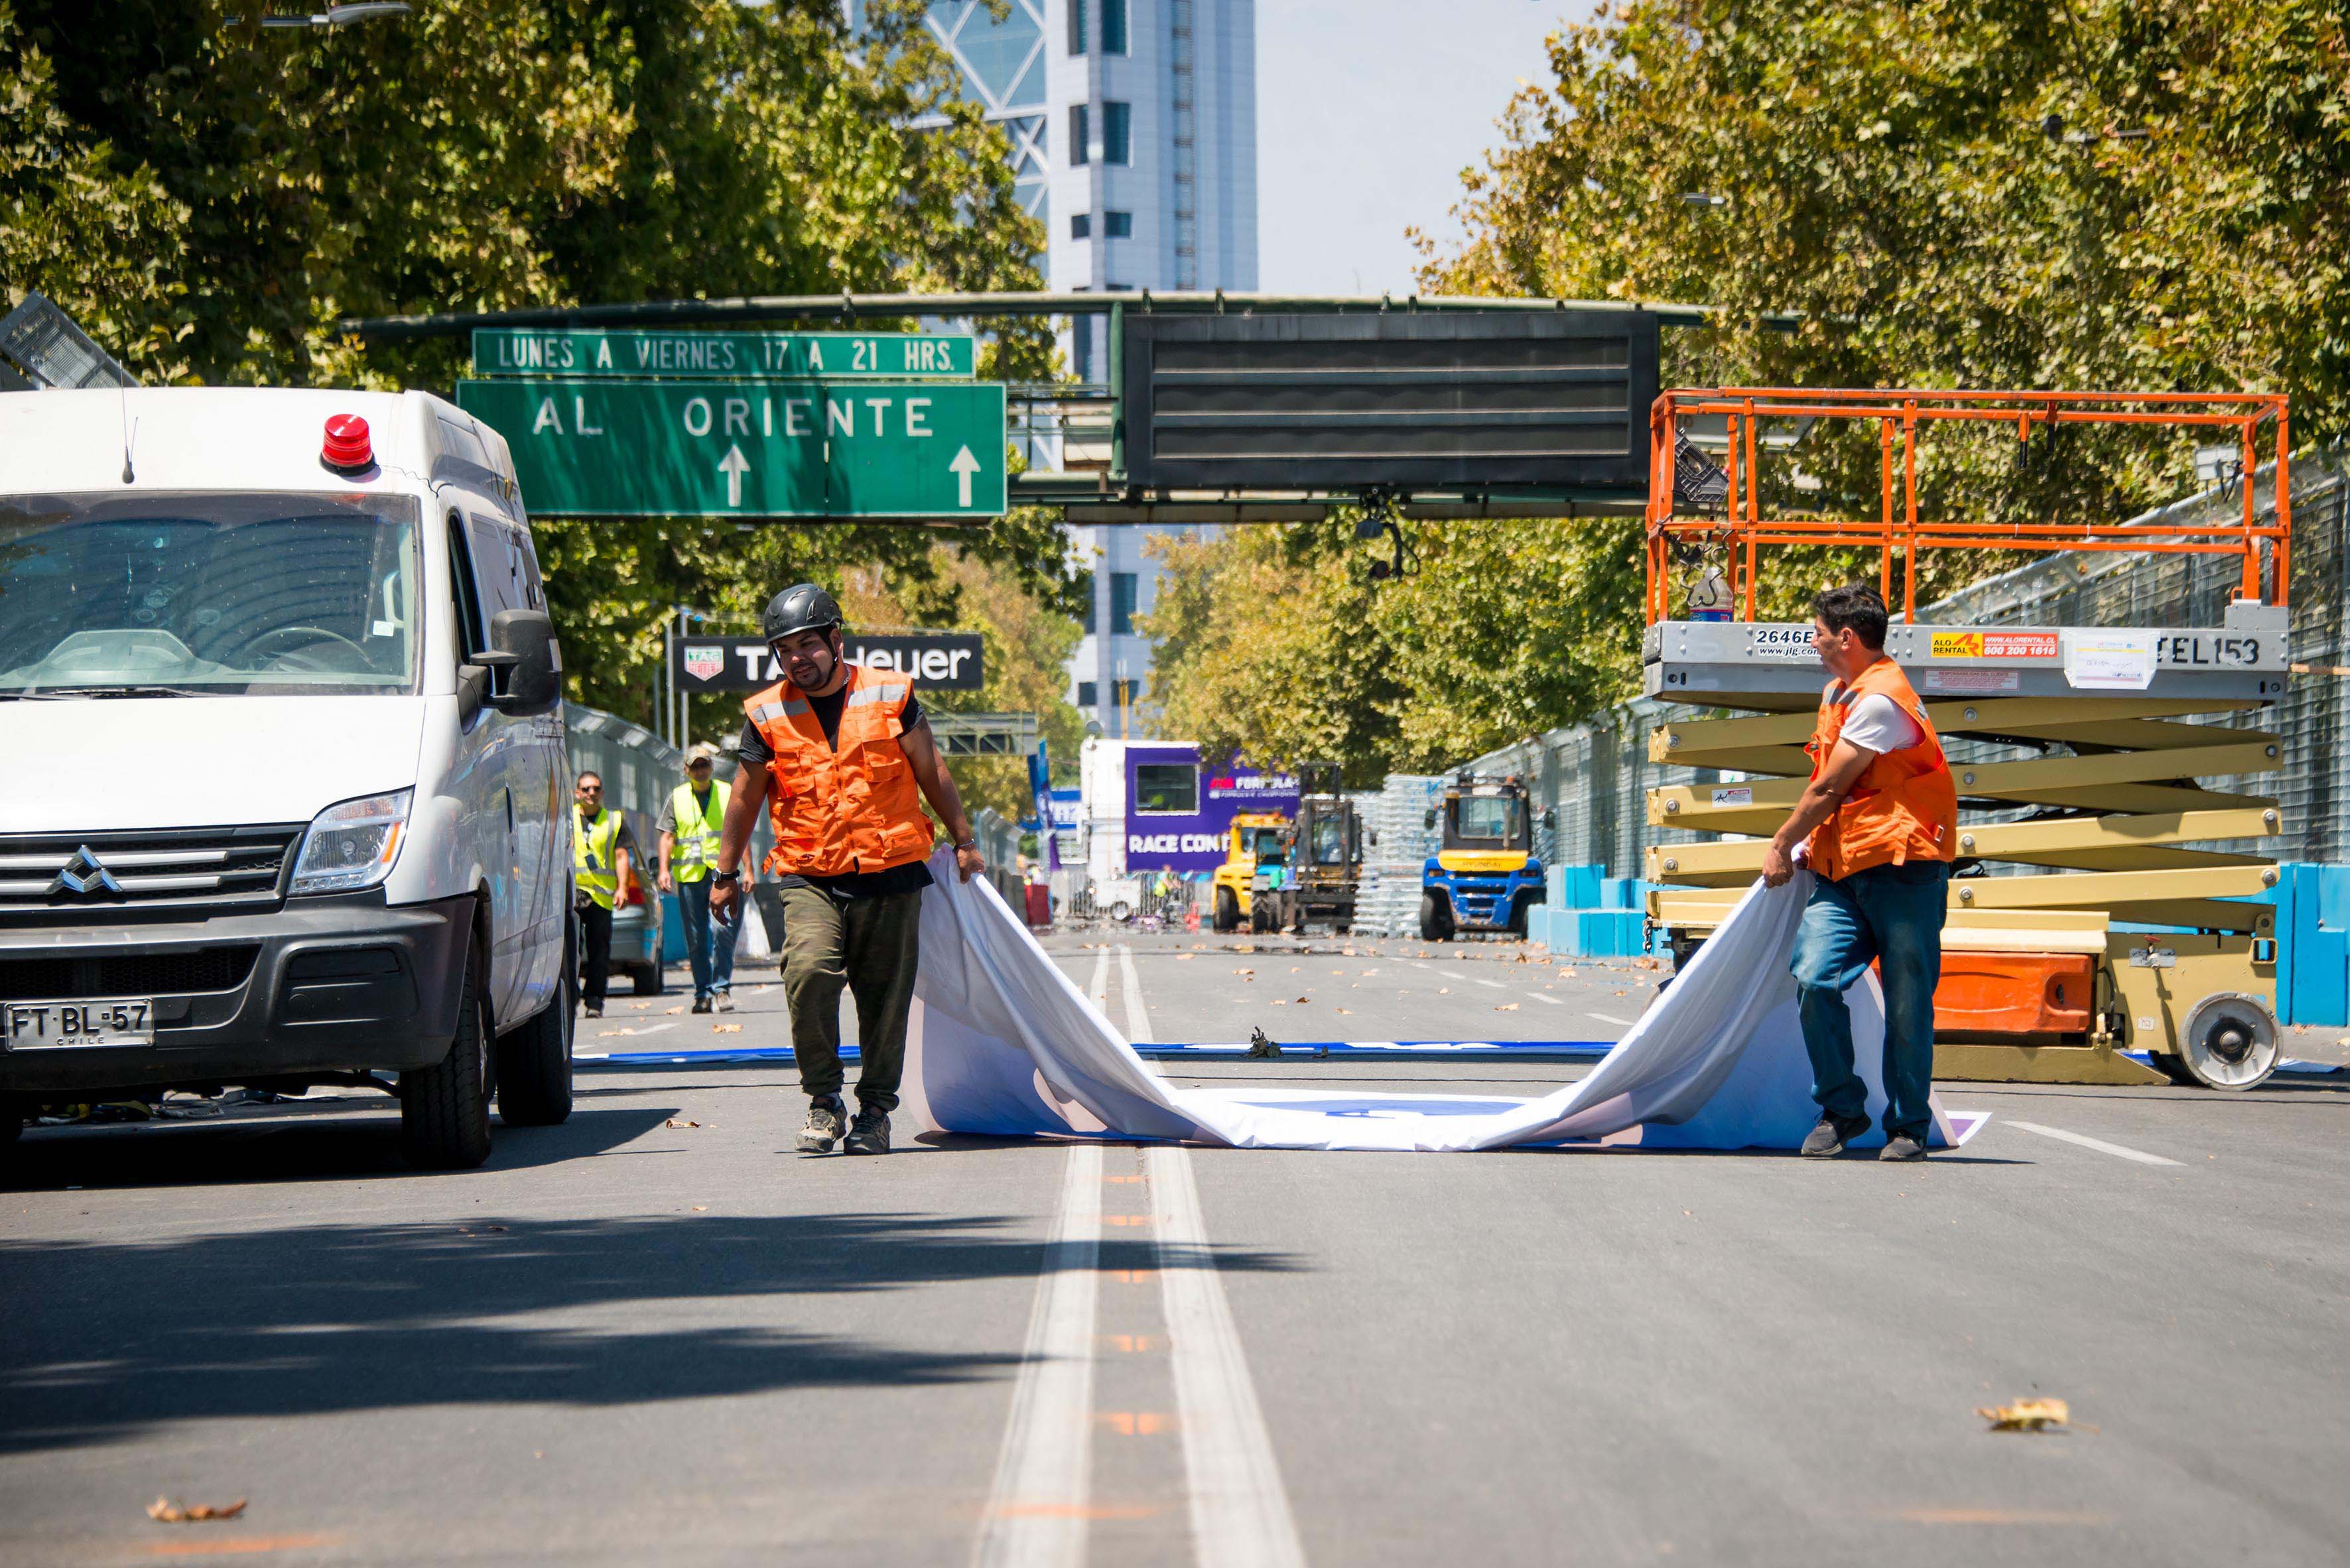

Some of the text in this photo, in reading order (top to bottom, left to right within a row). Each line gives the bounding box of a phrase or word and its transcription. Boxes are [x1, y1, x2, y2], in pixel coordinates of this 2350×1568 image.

[499, 337, 954, 371] LUNES A VIERNES 17 A 21 HRS.
[533, 397, 933, 437] AL ORIENTE
[1984, 647, 2056, 655] 600 200 1616
[1129, 834, 1179, 853] RACE
[56, 1035, 105, 1046] CHILE
